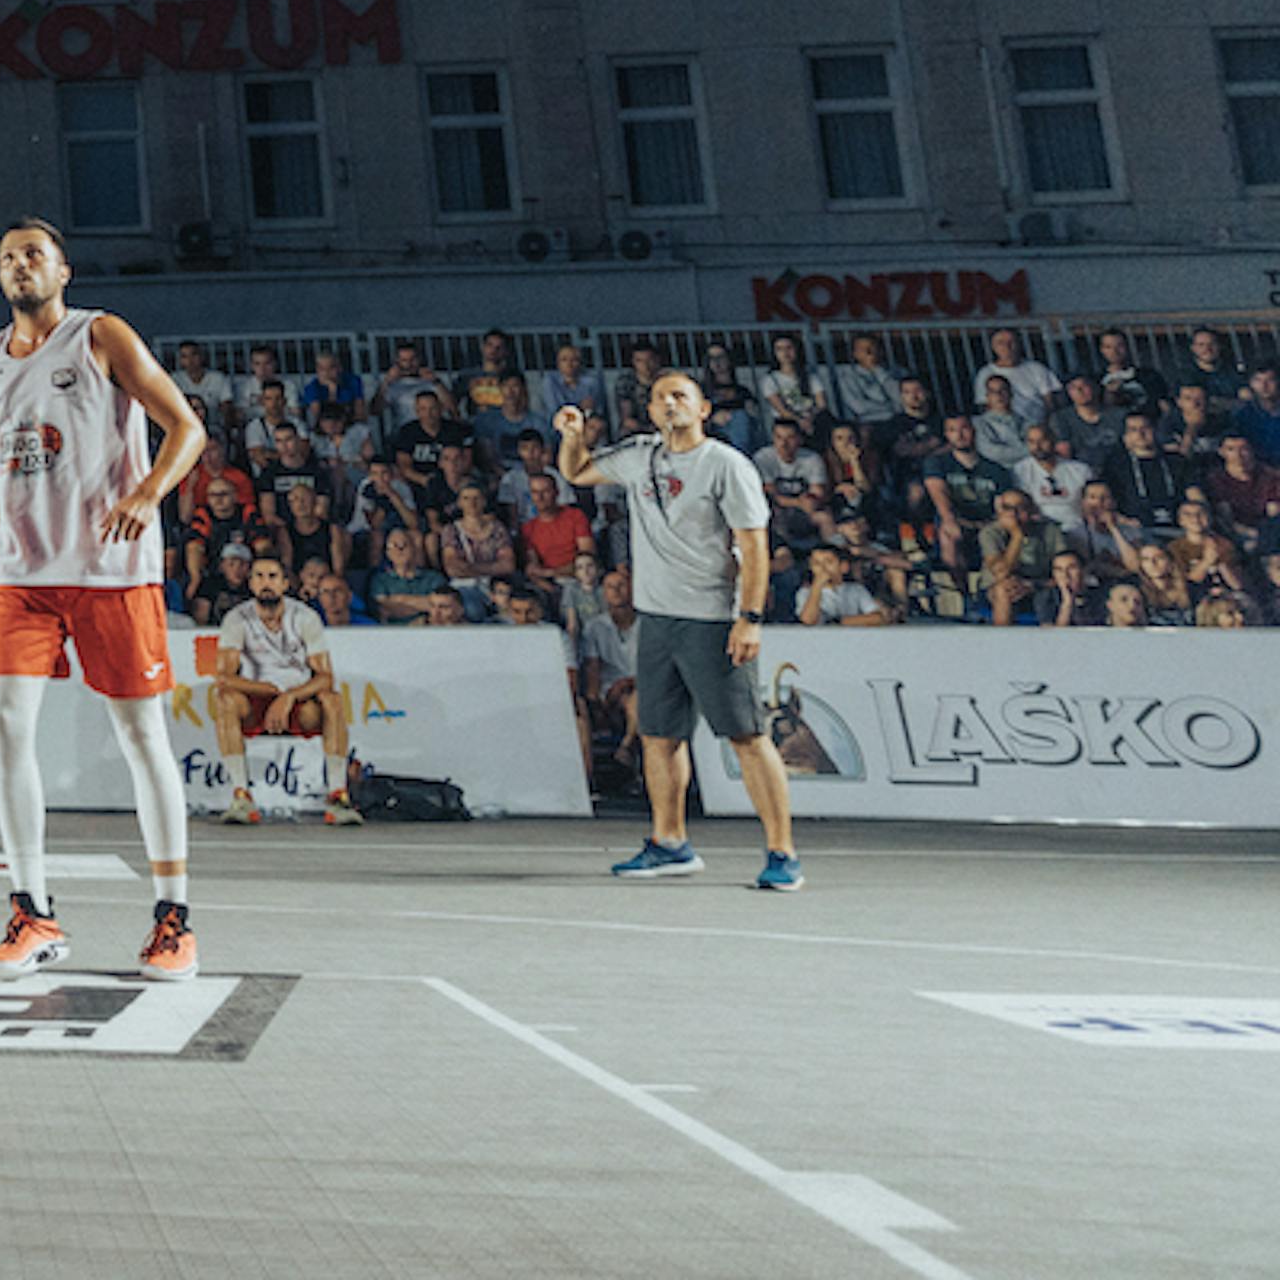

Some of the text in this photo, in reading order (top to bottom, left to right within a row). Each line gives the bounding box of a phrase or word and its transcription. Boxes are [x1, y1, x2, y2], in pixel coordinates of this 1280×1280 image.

[752, 269, 1031, 324] KONZUM
[868, 677, 1262, 787] LAŠKO
[265, 747, 300, 796] of
